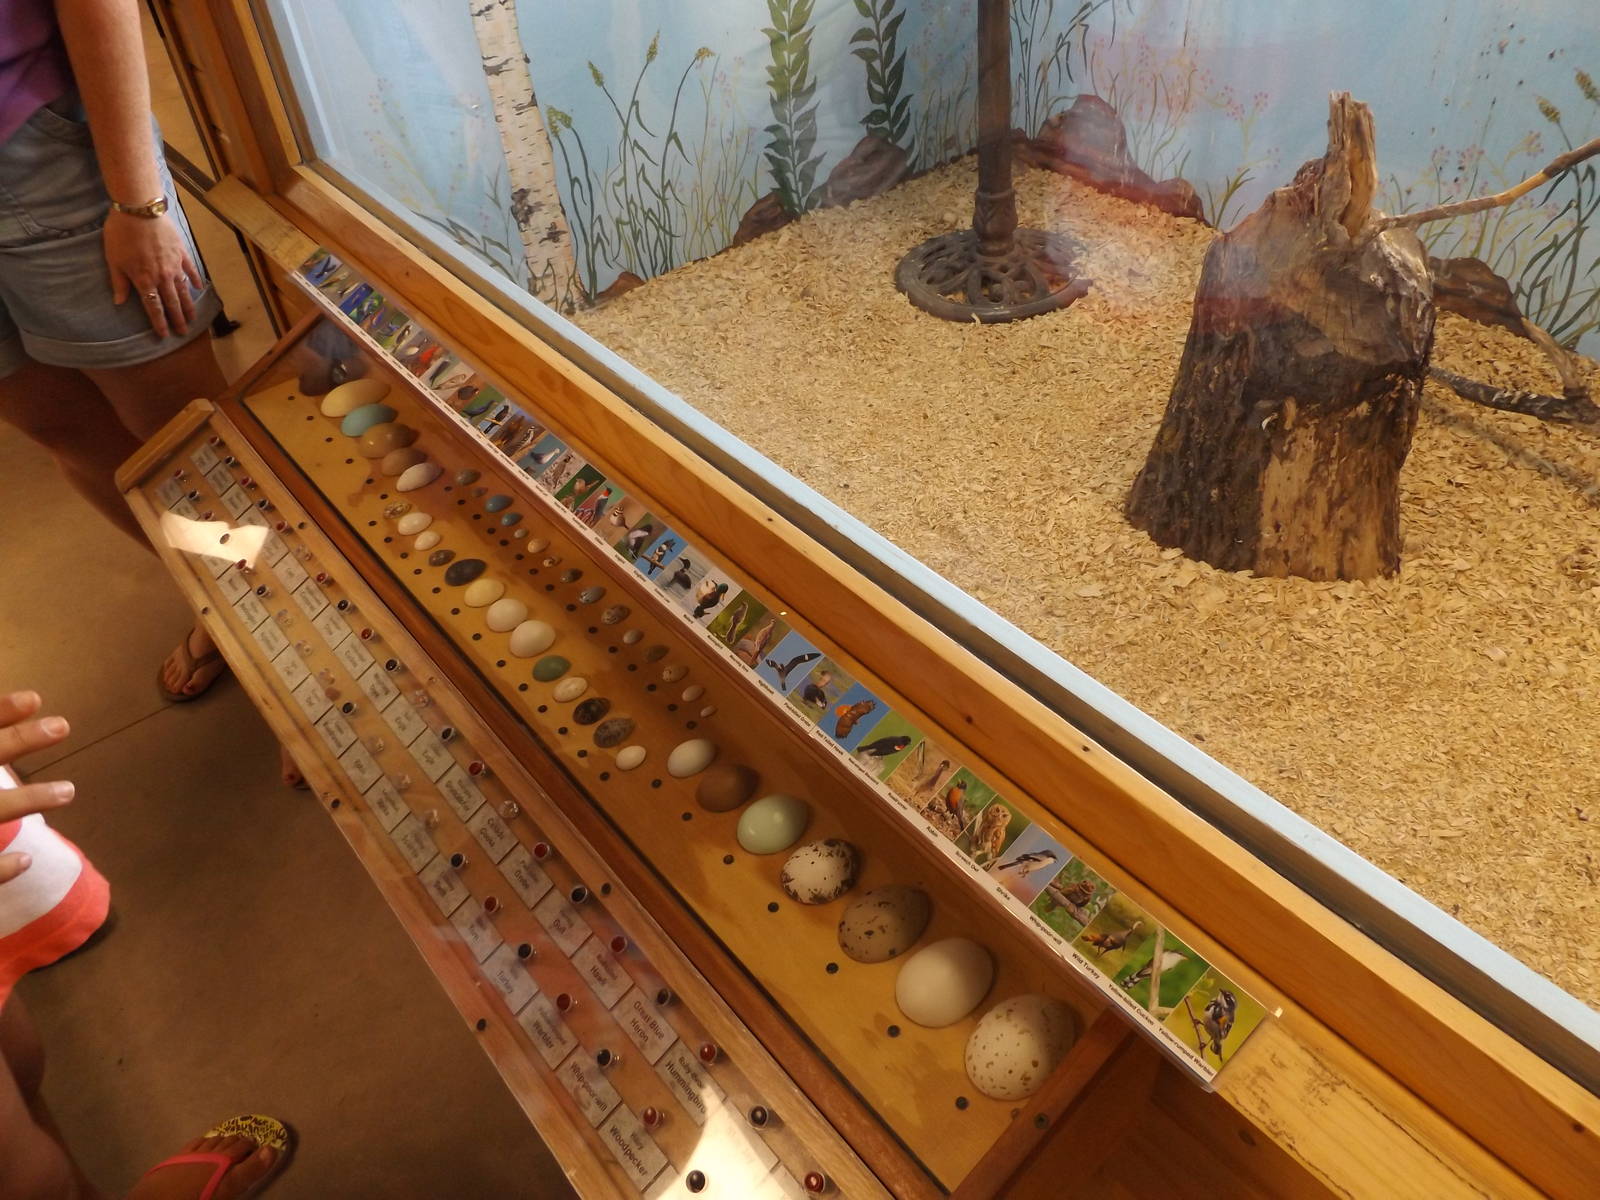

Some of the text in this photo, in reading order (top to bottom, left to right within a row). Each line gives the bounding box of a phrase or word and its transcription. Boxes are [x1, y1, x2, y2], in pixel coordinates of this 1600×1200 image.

[995, 885, 1011, 901] Shrike
[1028, 914, 1064, 946] Whip-poor-will
[1080, 959, 1101, 980] Turkey
[1135, 1007, 1155, 1027] Cuckoo
[631, 1018, 649, 1043] Heron
[649, 1021, 665, 1040] Blue
[608, 1124, 649, 1177] Woodpecker
